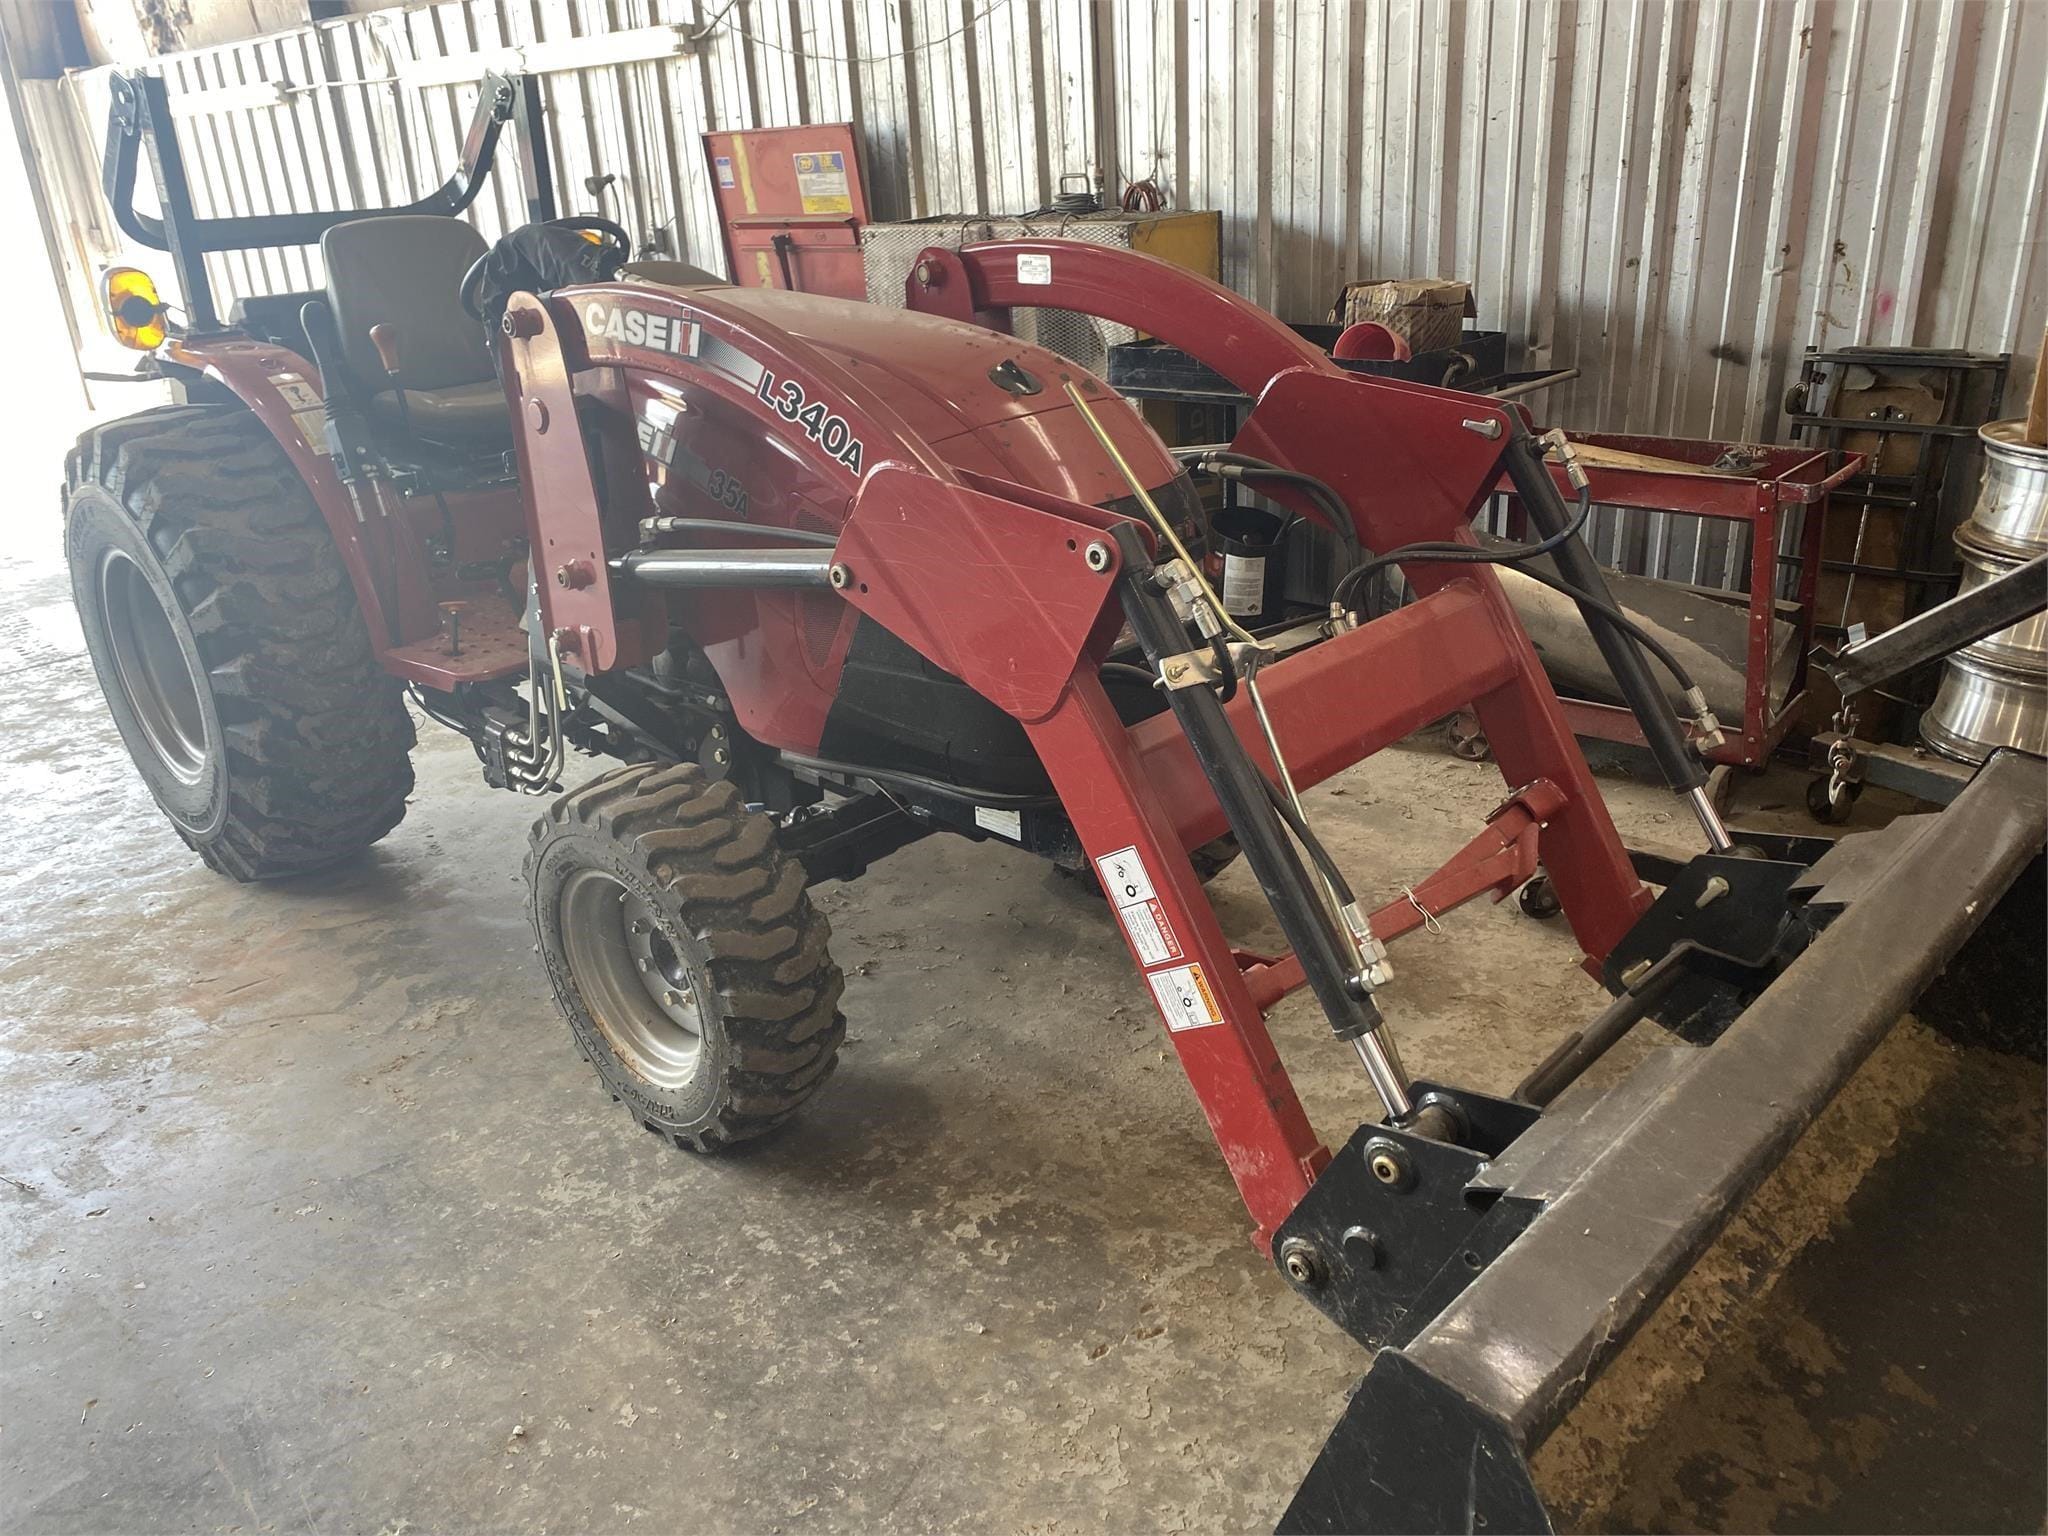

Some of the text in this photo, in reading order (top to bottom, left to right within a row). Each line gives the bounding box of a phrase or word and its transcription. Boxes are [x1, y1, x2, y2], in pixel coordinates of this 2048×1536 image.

[585, 302, 668, 351] CASE
[758, 370, 864, 478] L340A
[709, 468, 750, 519] 35A
[1155, 912, 1177, 954] DANGER
[1198, 980, 1217, 1017] WARNING
